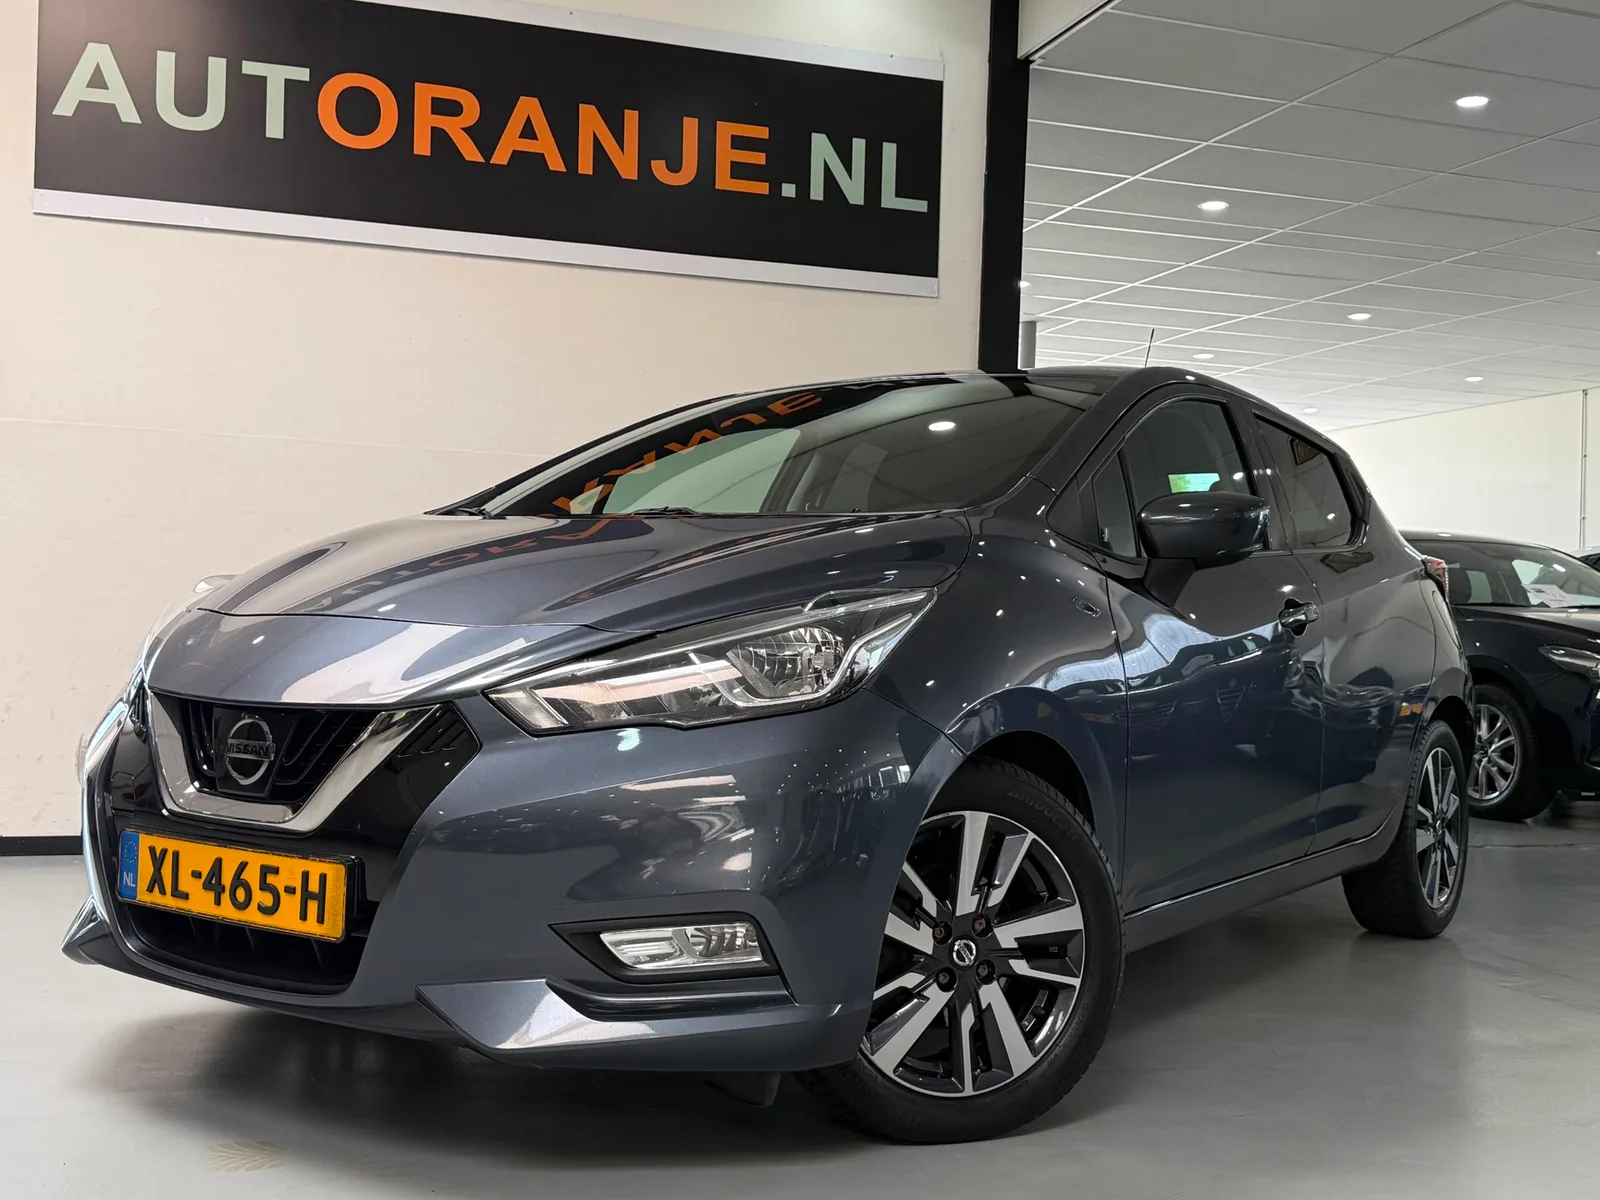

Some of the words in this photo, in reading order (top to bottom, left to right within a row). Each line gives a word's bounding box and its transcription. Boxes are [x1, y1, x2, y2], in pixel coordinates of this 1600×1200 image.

[52, 41, 929, 213] AUTORANJE.NL
[225, 741, 269, 757] NISSAN
[123, 871, 136, 887] NL
[146, 844, 328, 925] XL-465-H
